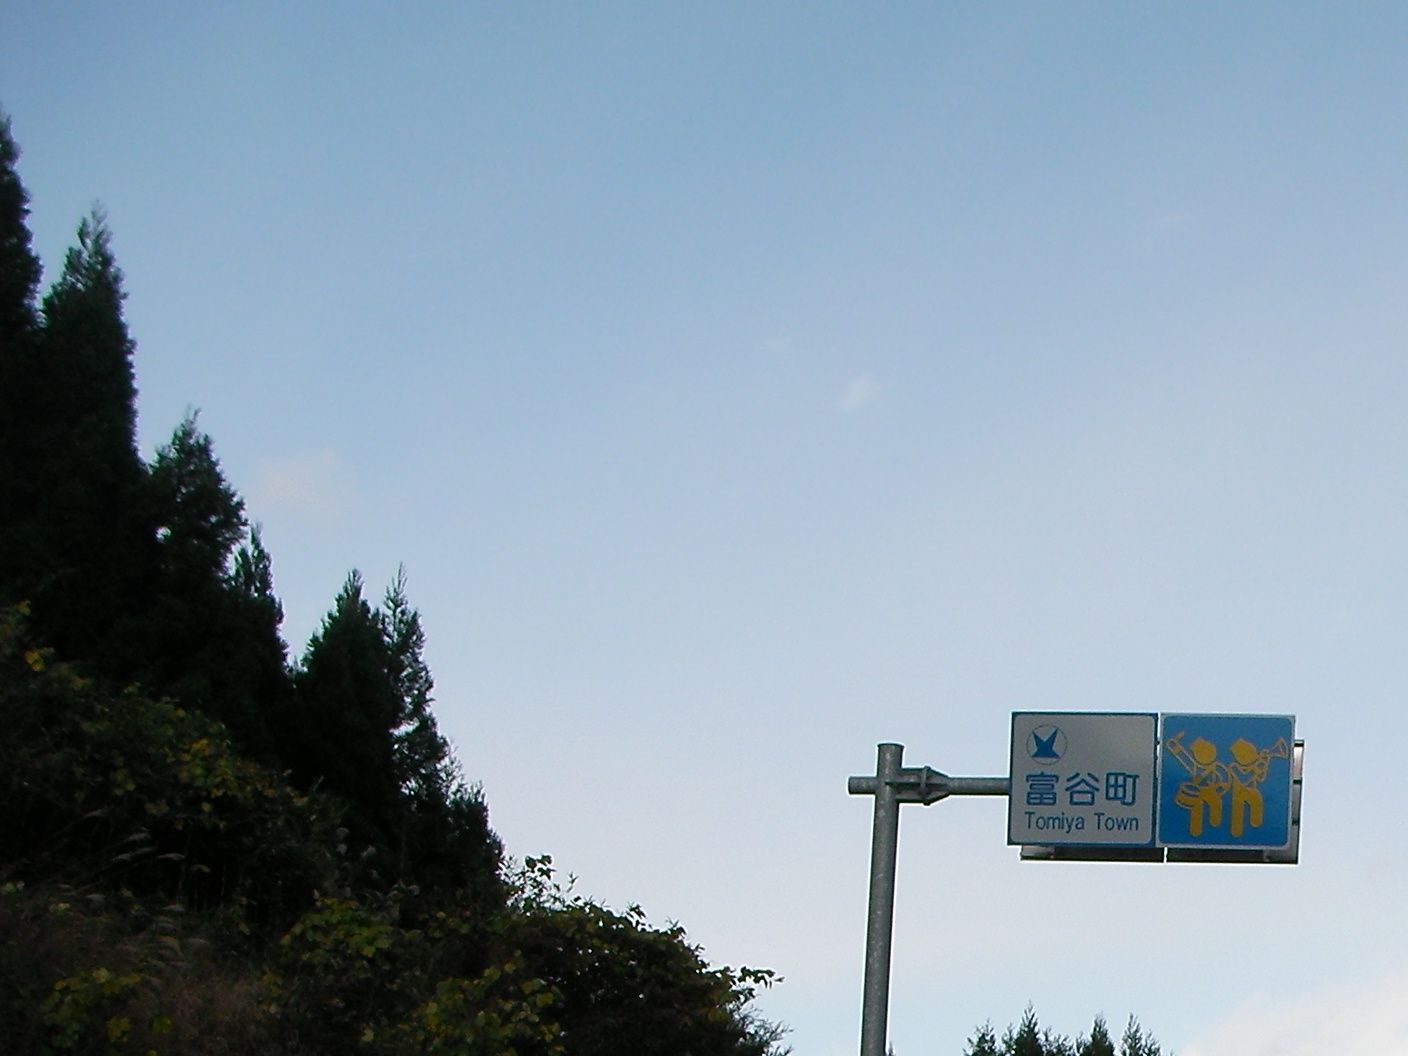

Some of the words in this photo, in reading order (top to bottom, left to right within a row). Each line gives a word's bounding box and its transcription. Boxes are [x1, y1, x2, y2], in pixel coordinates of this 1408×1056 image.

[1025, 771, 1140, 807] 富谷町
[1024, 811, 1085, 834] Tomiya
[1094, 812, 1139, 831] Town
